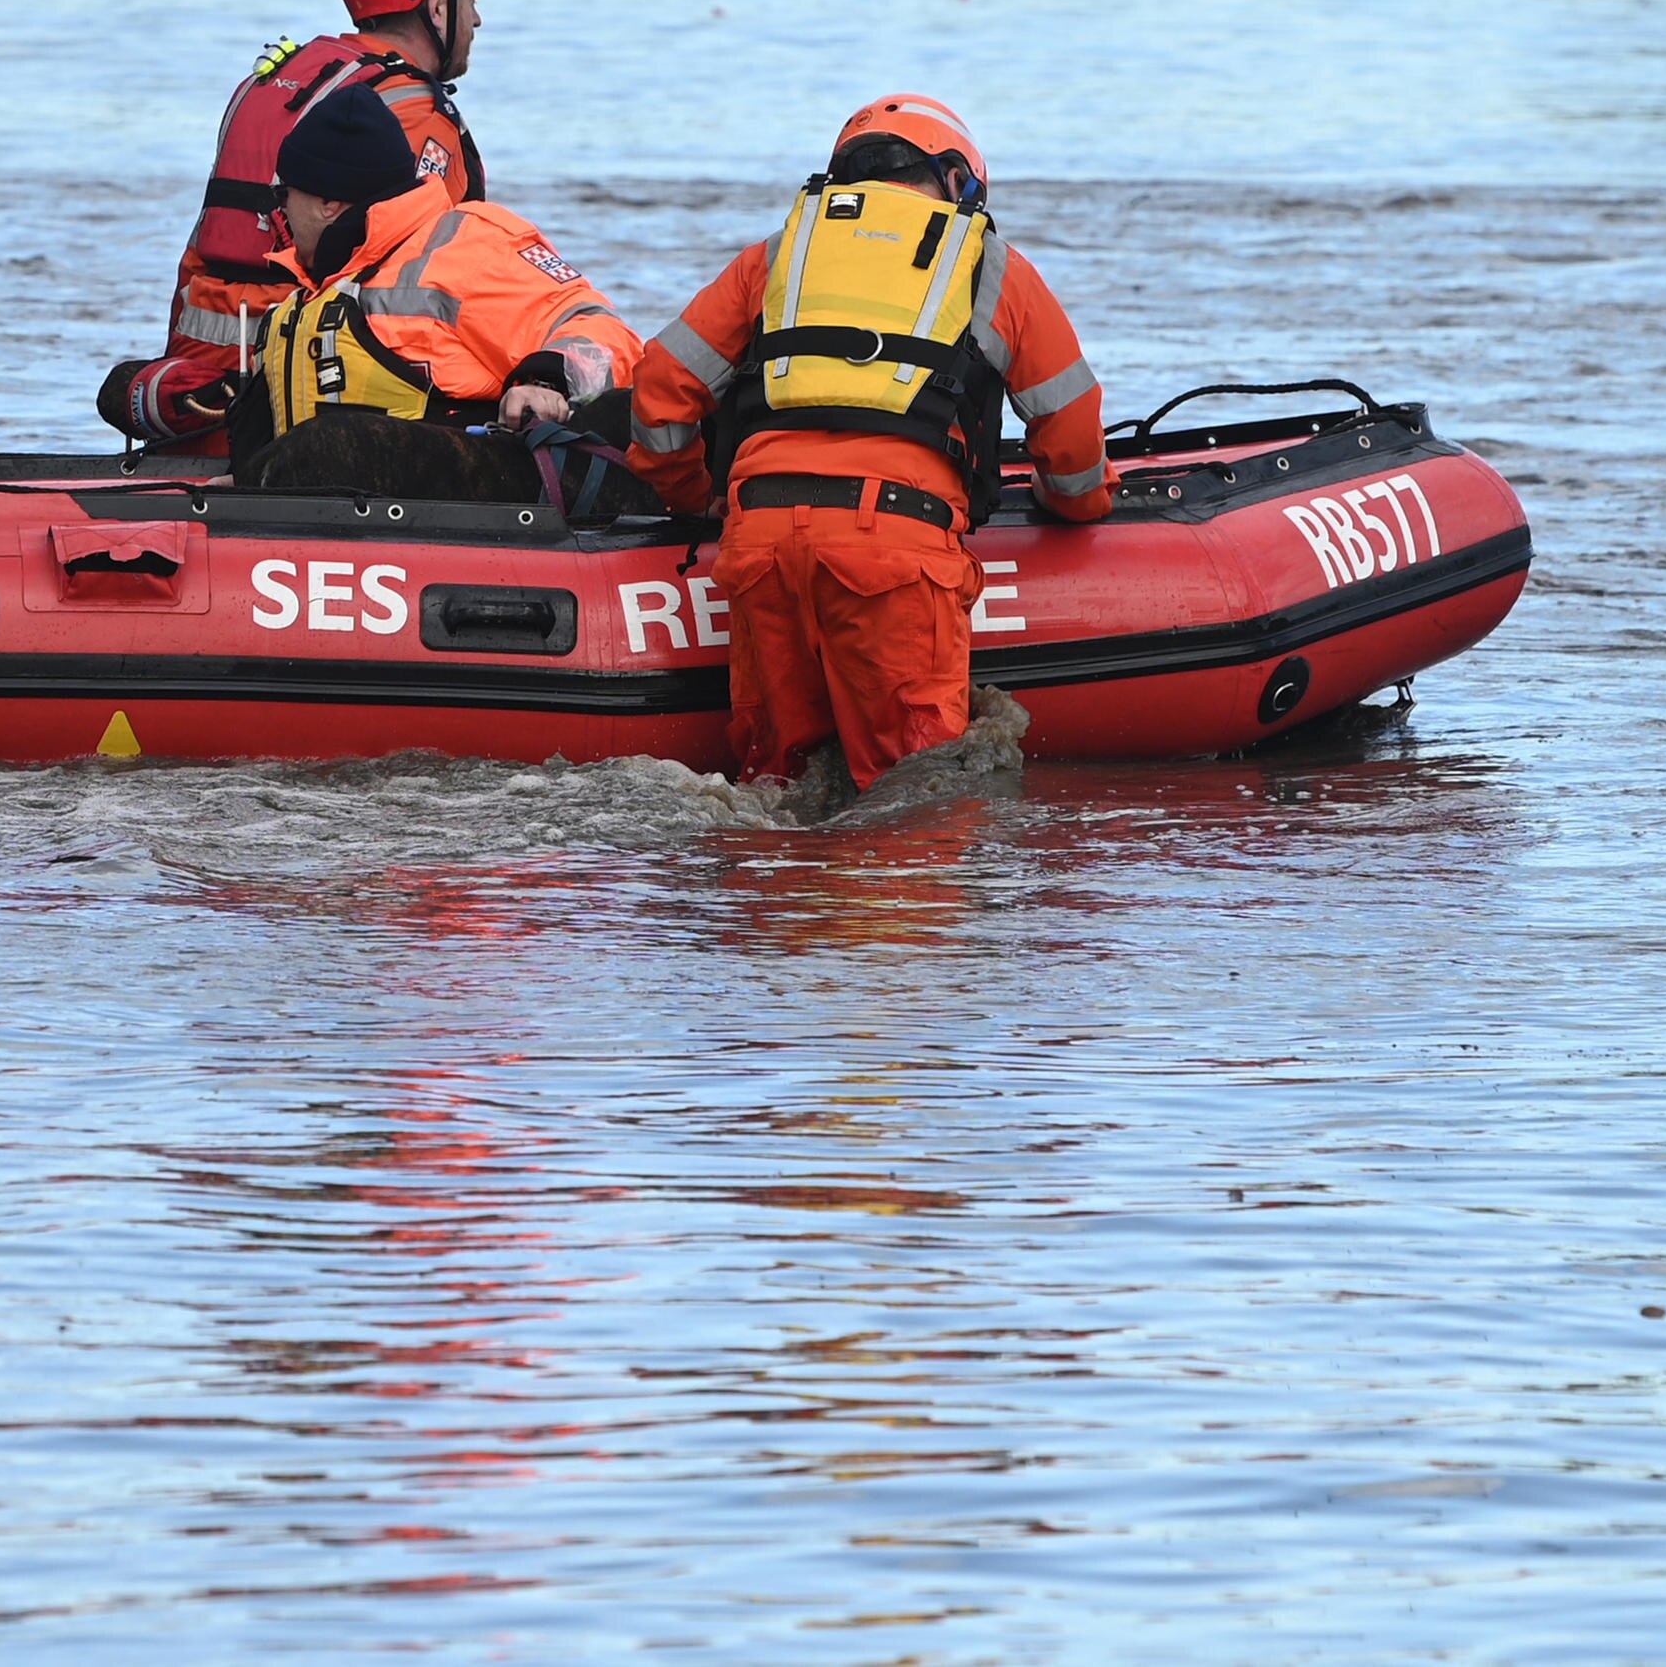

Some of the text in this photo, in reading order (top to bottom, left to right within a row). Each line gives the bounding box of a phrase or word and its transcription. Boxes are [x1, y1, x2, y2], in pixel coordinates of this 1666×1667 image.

[1282, 473, 1442, 589] RB577
[251, 559, 1028, 653] SES REE
